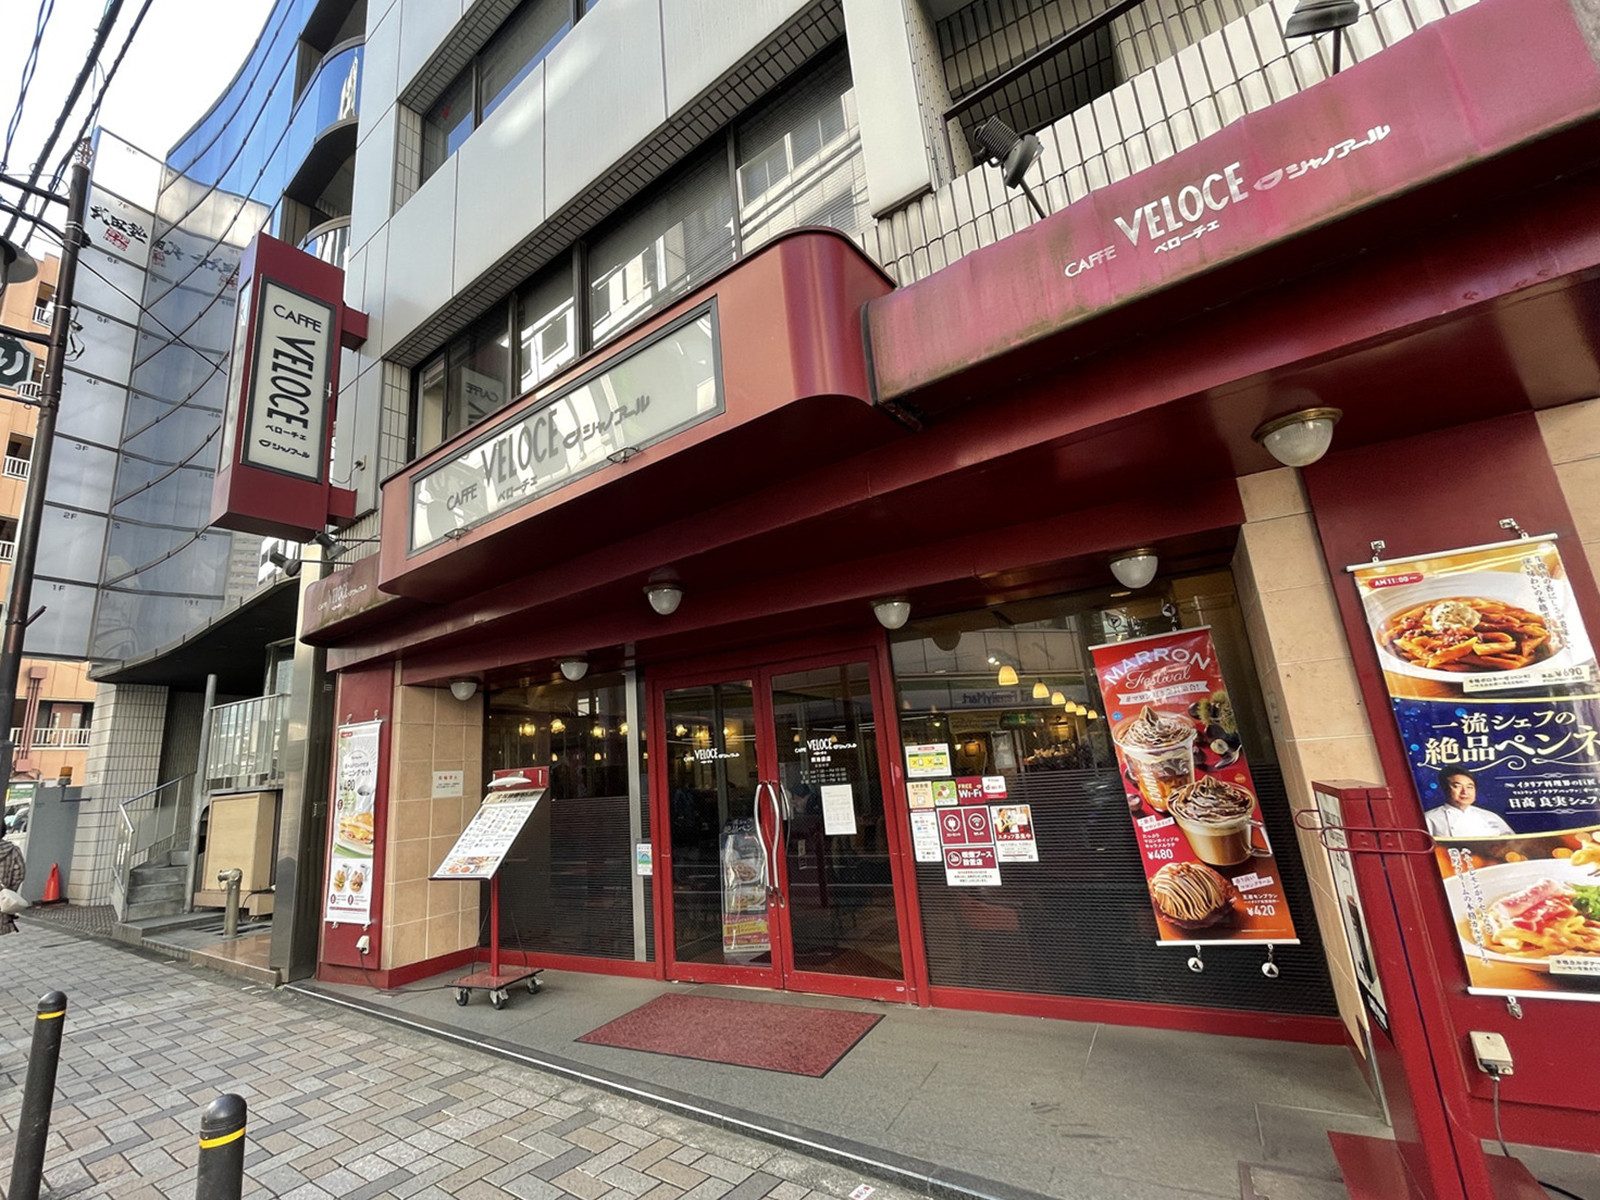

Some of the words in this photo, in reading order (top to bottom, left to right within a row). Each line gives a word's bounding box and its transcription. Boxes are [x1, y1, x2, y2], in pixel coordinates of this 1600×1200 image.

[1064, 245, 1117, 278] CAFFE
[1113, 161, 1248, 247] VELOCE
[1154, 220, 1220, 253] ベローチェ
[272, 304, 323, 335] CAFFE
[266, 335, 317, 431] VELOCE
[446, 482, 478, 512] CAFFE
[480, 408, 559, 488] VELOCE
[1104, 648, 1210, 686] MARRON
[1125, 665, 1191, 689] Festival
[1431, 710, 1576, 734] 一流シェフの
[1424, 724, 1600, 765] 絶品ペンネ
[1146, 848, 1174, 861] ¥480
[1246, 904, 1276, 917] ¥420
